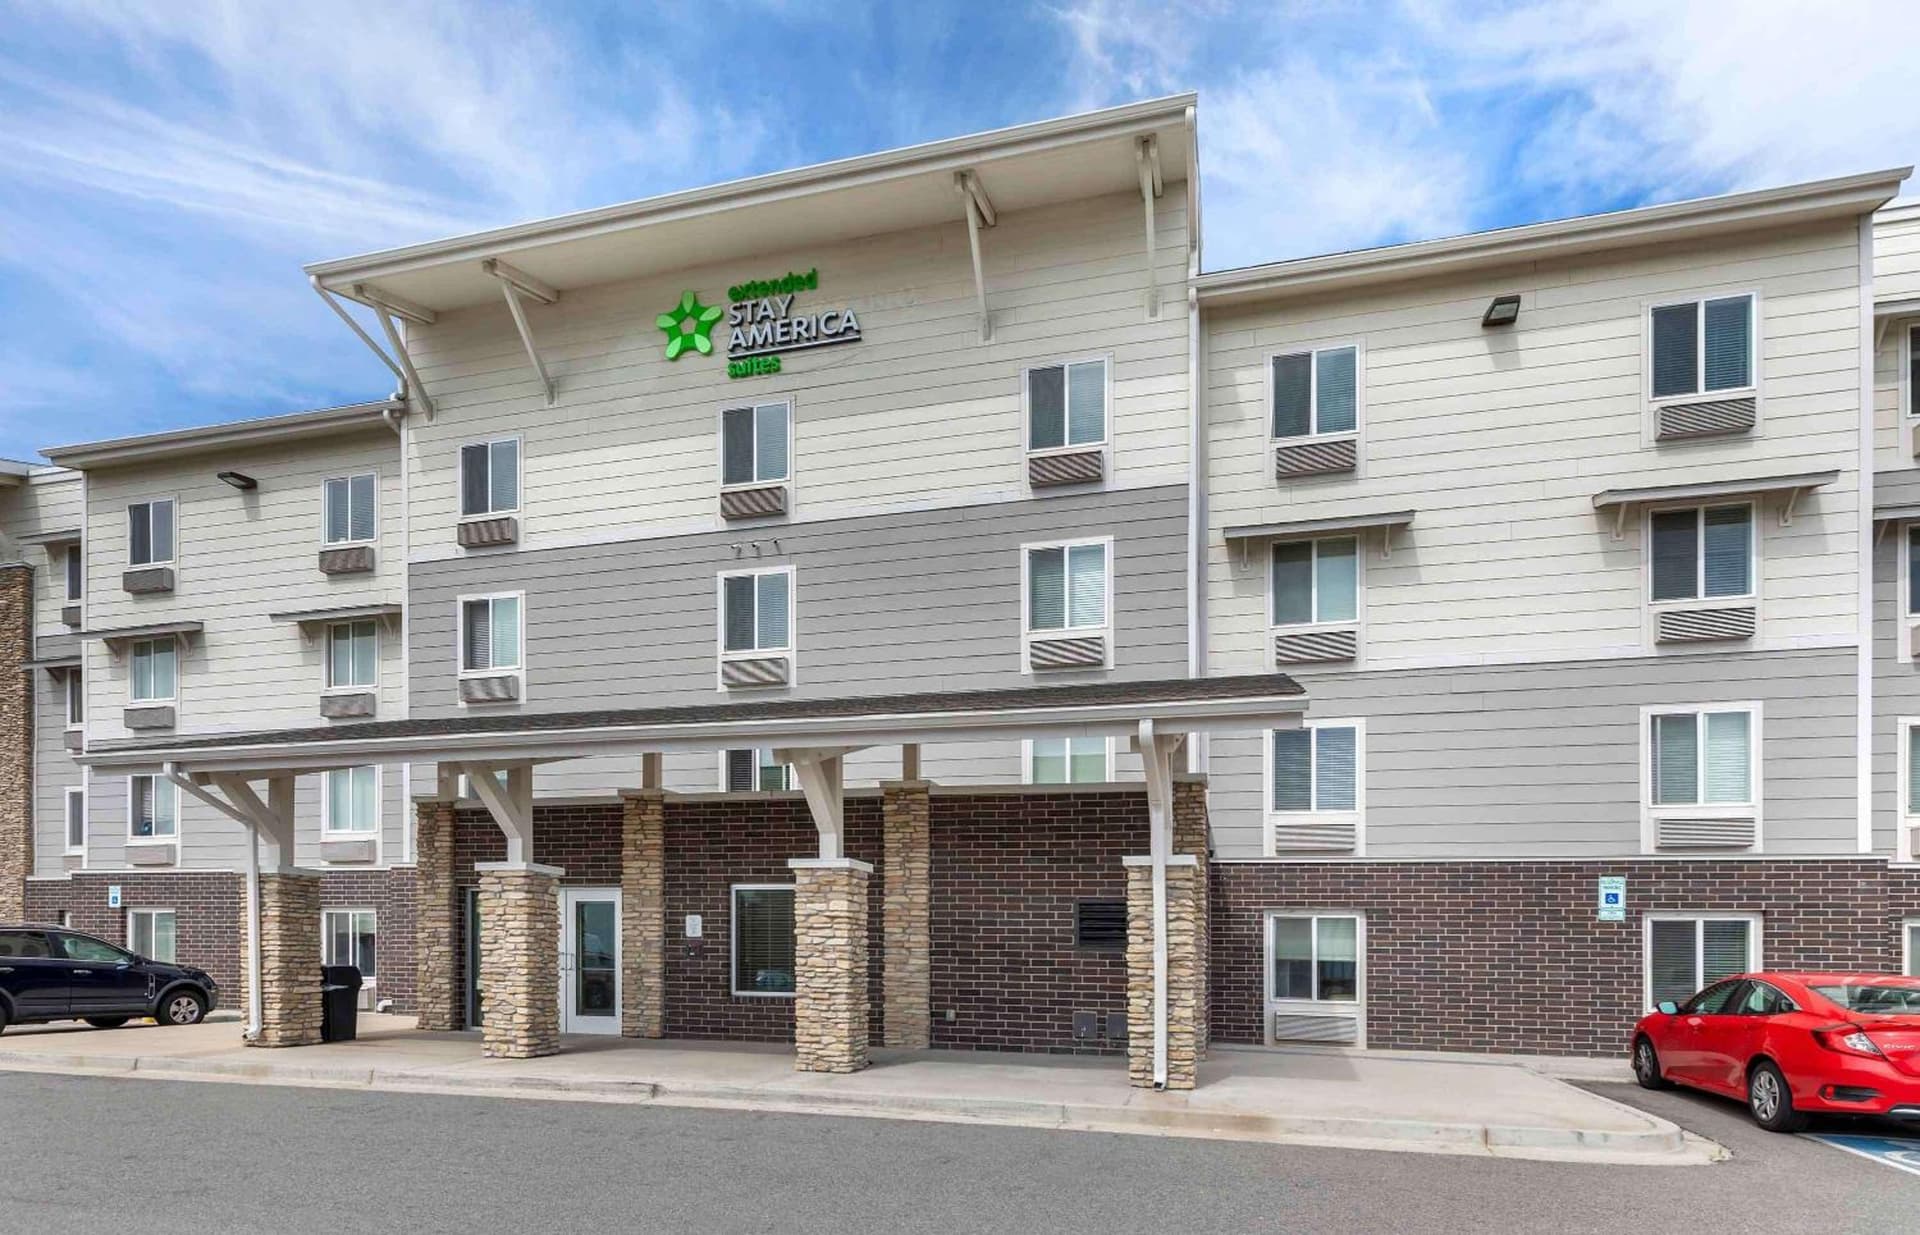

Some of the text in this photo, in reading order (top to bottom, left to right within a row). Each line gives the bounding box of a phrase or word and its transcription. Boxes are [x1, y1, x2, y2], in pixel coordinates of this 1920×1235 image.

[728, 267, 818, 303] extended
[728, 294, 795, 326] STAY
[727, 308, 861, 351] AMERICA
[727, 356, 782, 379] suites
